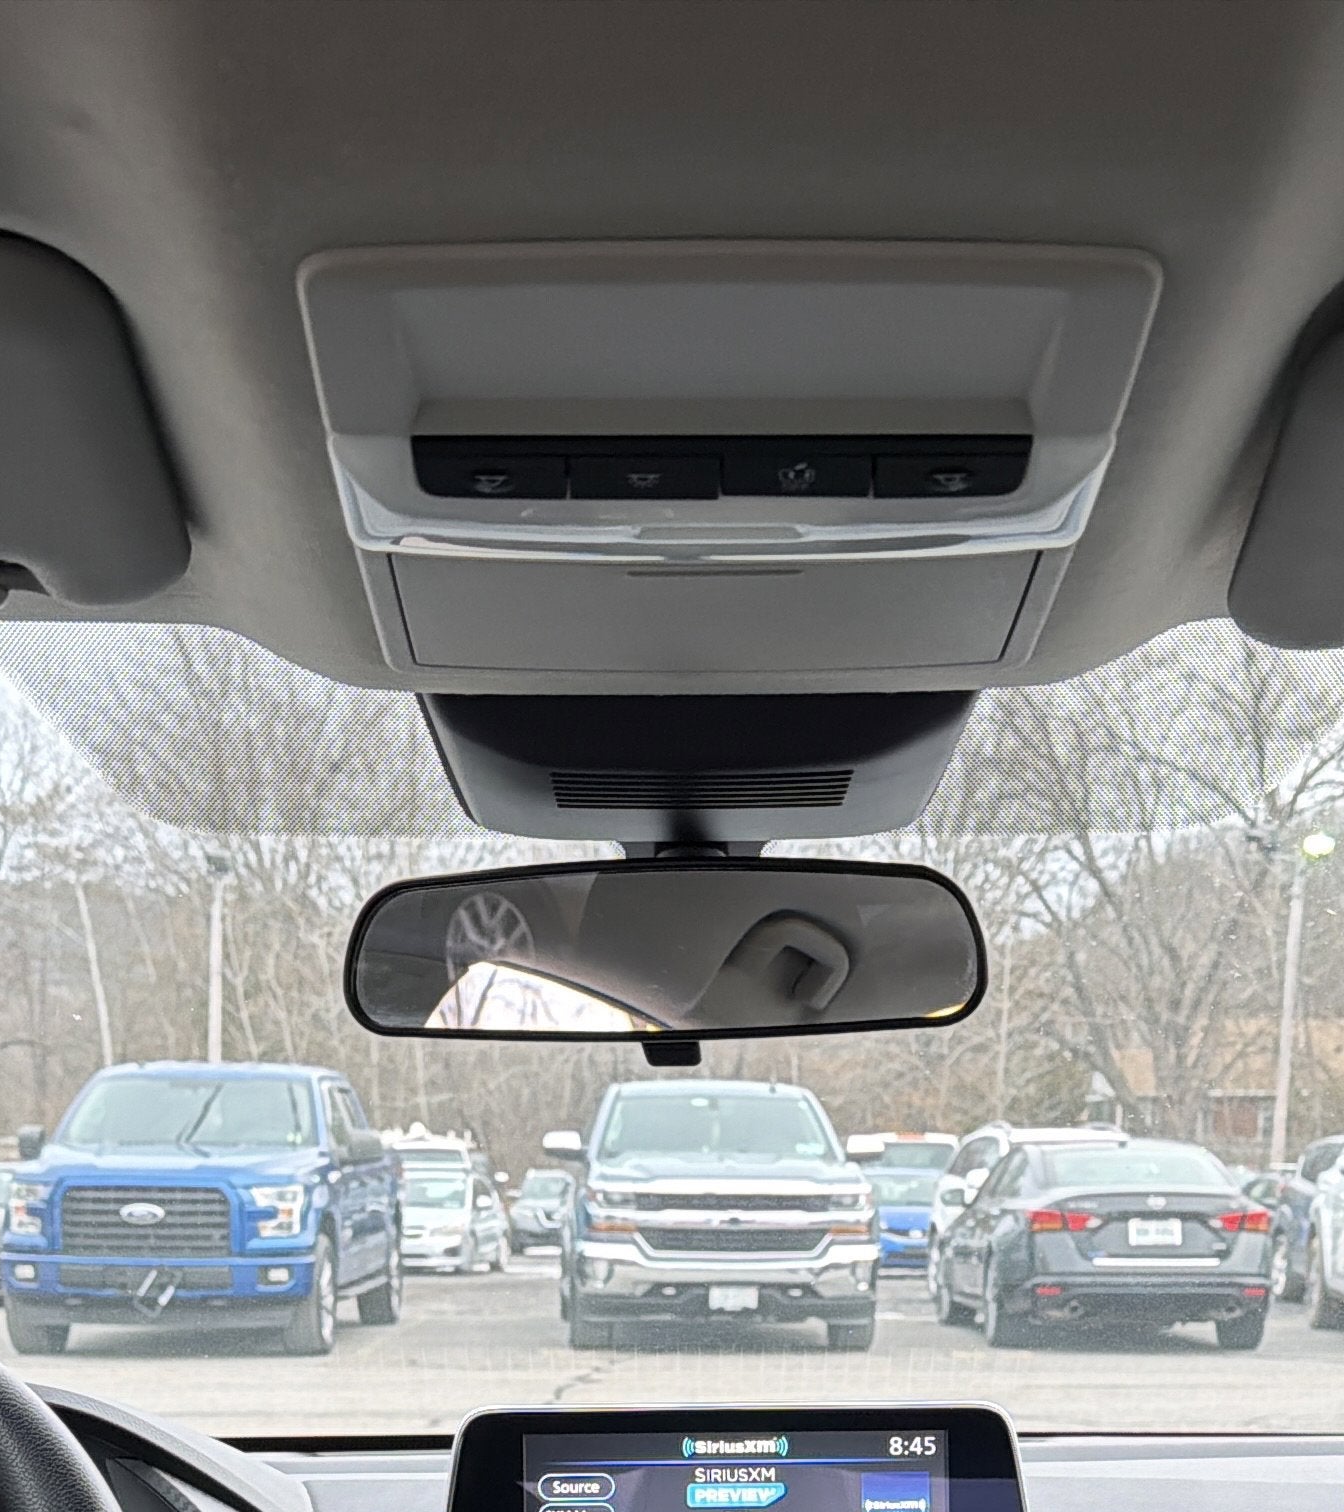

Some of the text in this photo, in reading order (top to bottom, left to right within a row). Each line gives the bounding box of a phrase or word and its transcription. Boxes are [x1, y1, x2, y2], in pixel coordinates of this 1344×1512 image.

[888, 1436, 936, 1455] 8:45
[552, 1481, 600, 1494] Source
[694, 1488, 778, 1503] PREVIEW
